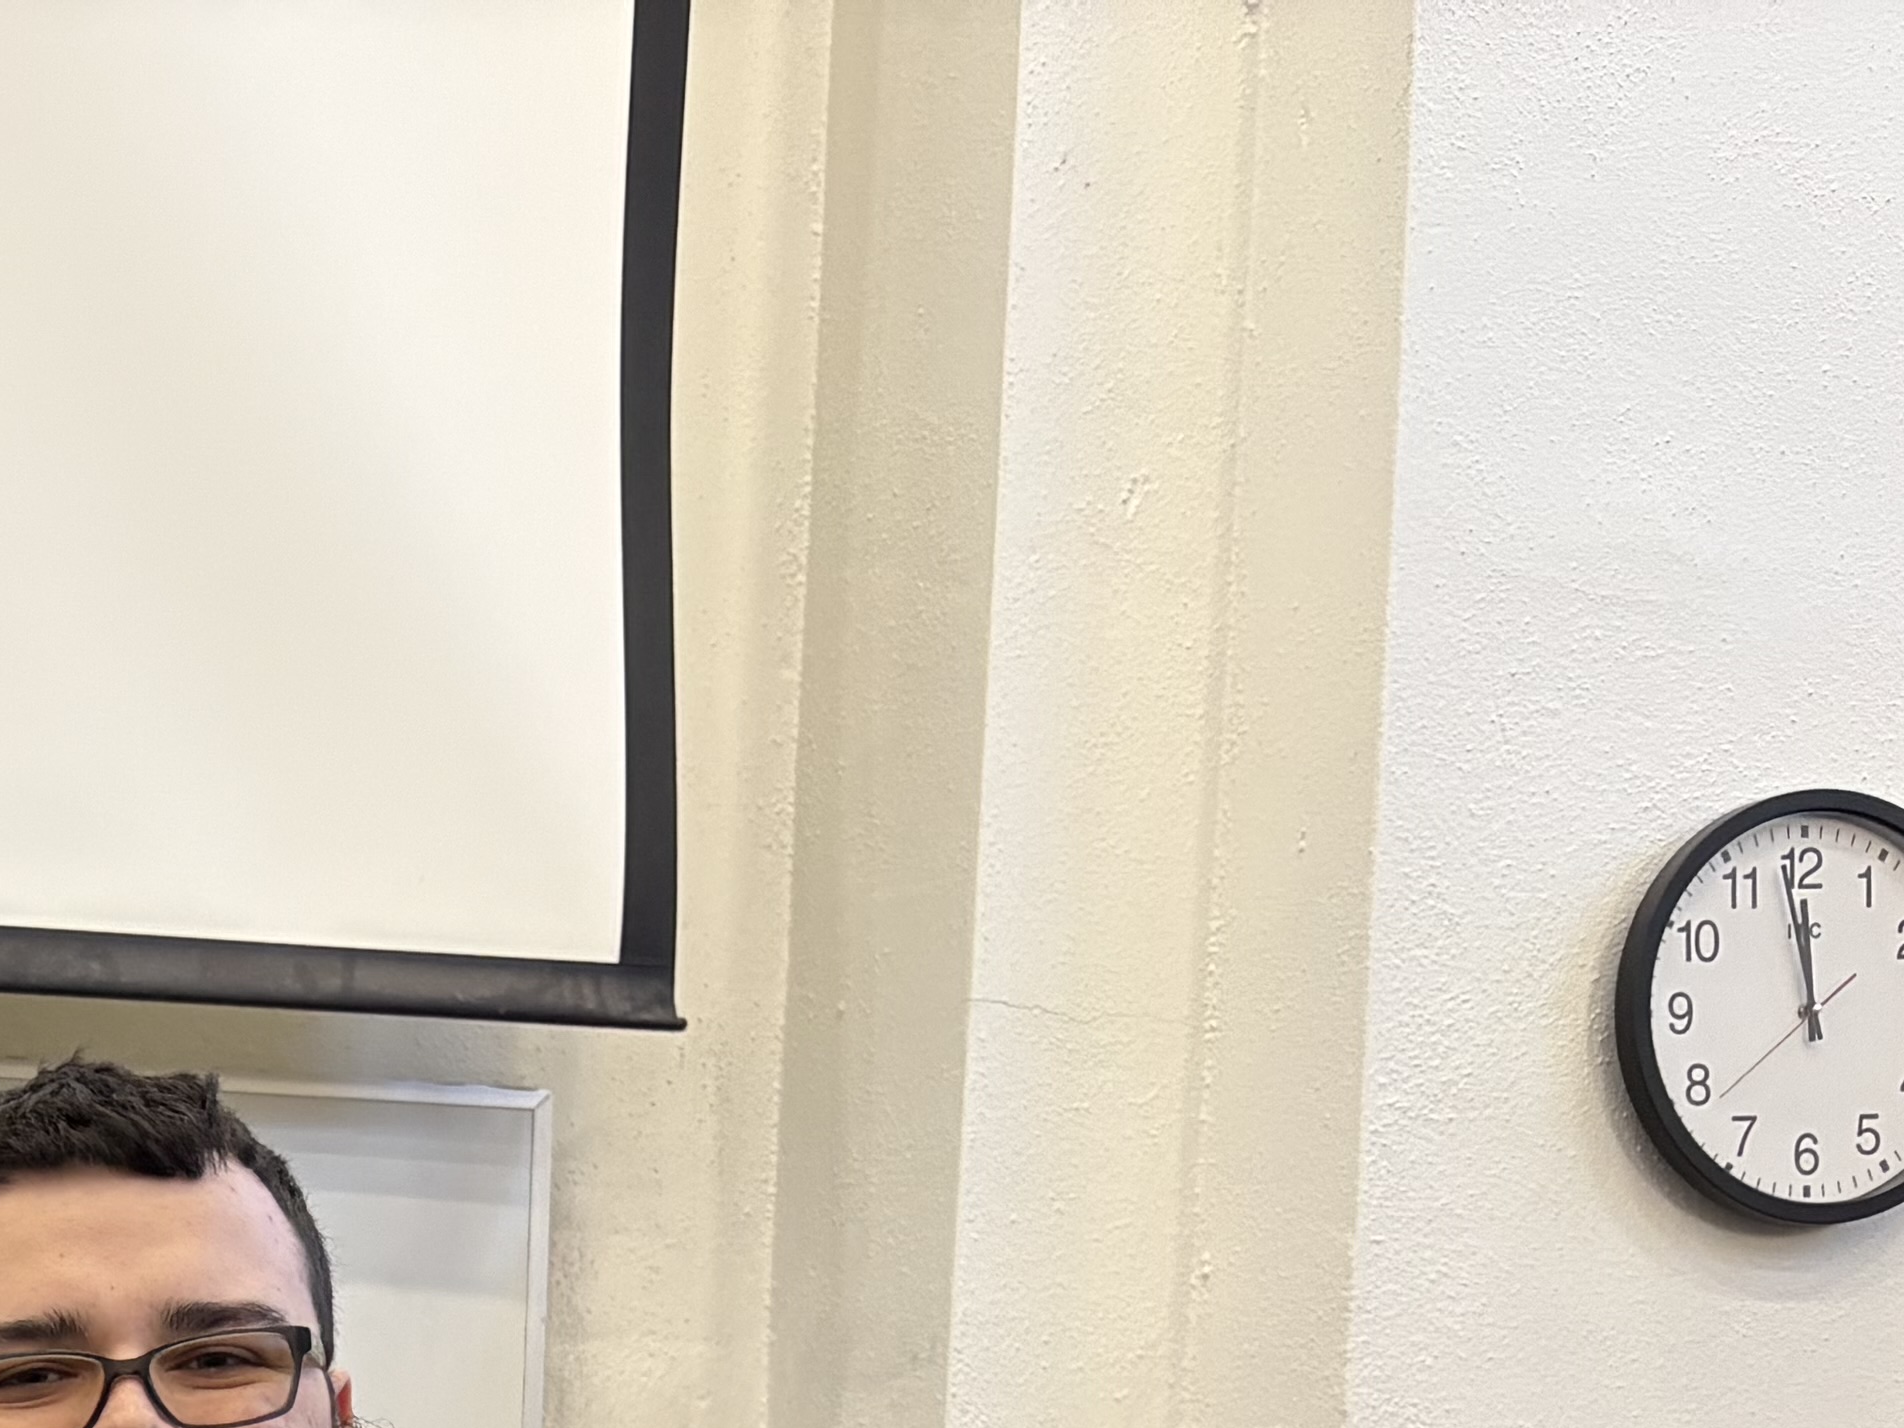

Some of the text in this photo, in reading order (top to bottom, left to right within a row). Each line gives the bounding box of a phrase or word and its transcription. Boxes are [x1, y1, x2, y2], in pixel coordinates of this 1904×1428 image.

[1722, 866, 1758, 909] 11
[1780, 847, 1823, 889] 12
[1857, 865, 1872, 908] 1
[1677, 919, 1720, 963] 10
[1667, 991, 1694, 1035] 9
[1685, 1063, 1711, 1106] 8
[1731, 1115, 1758, 1156] 7
[1794, 1132, 1820, 1175] 6
[1856, 1113, 1881, 1155] 5
